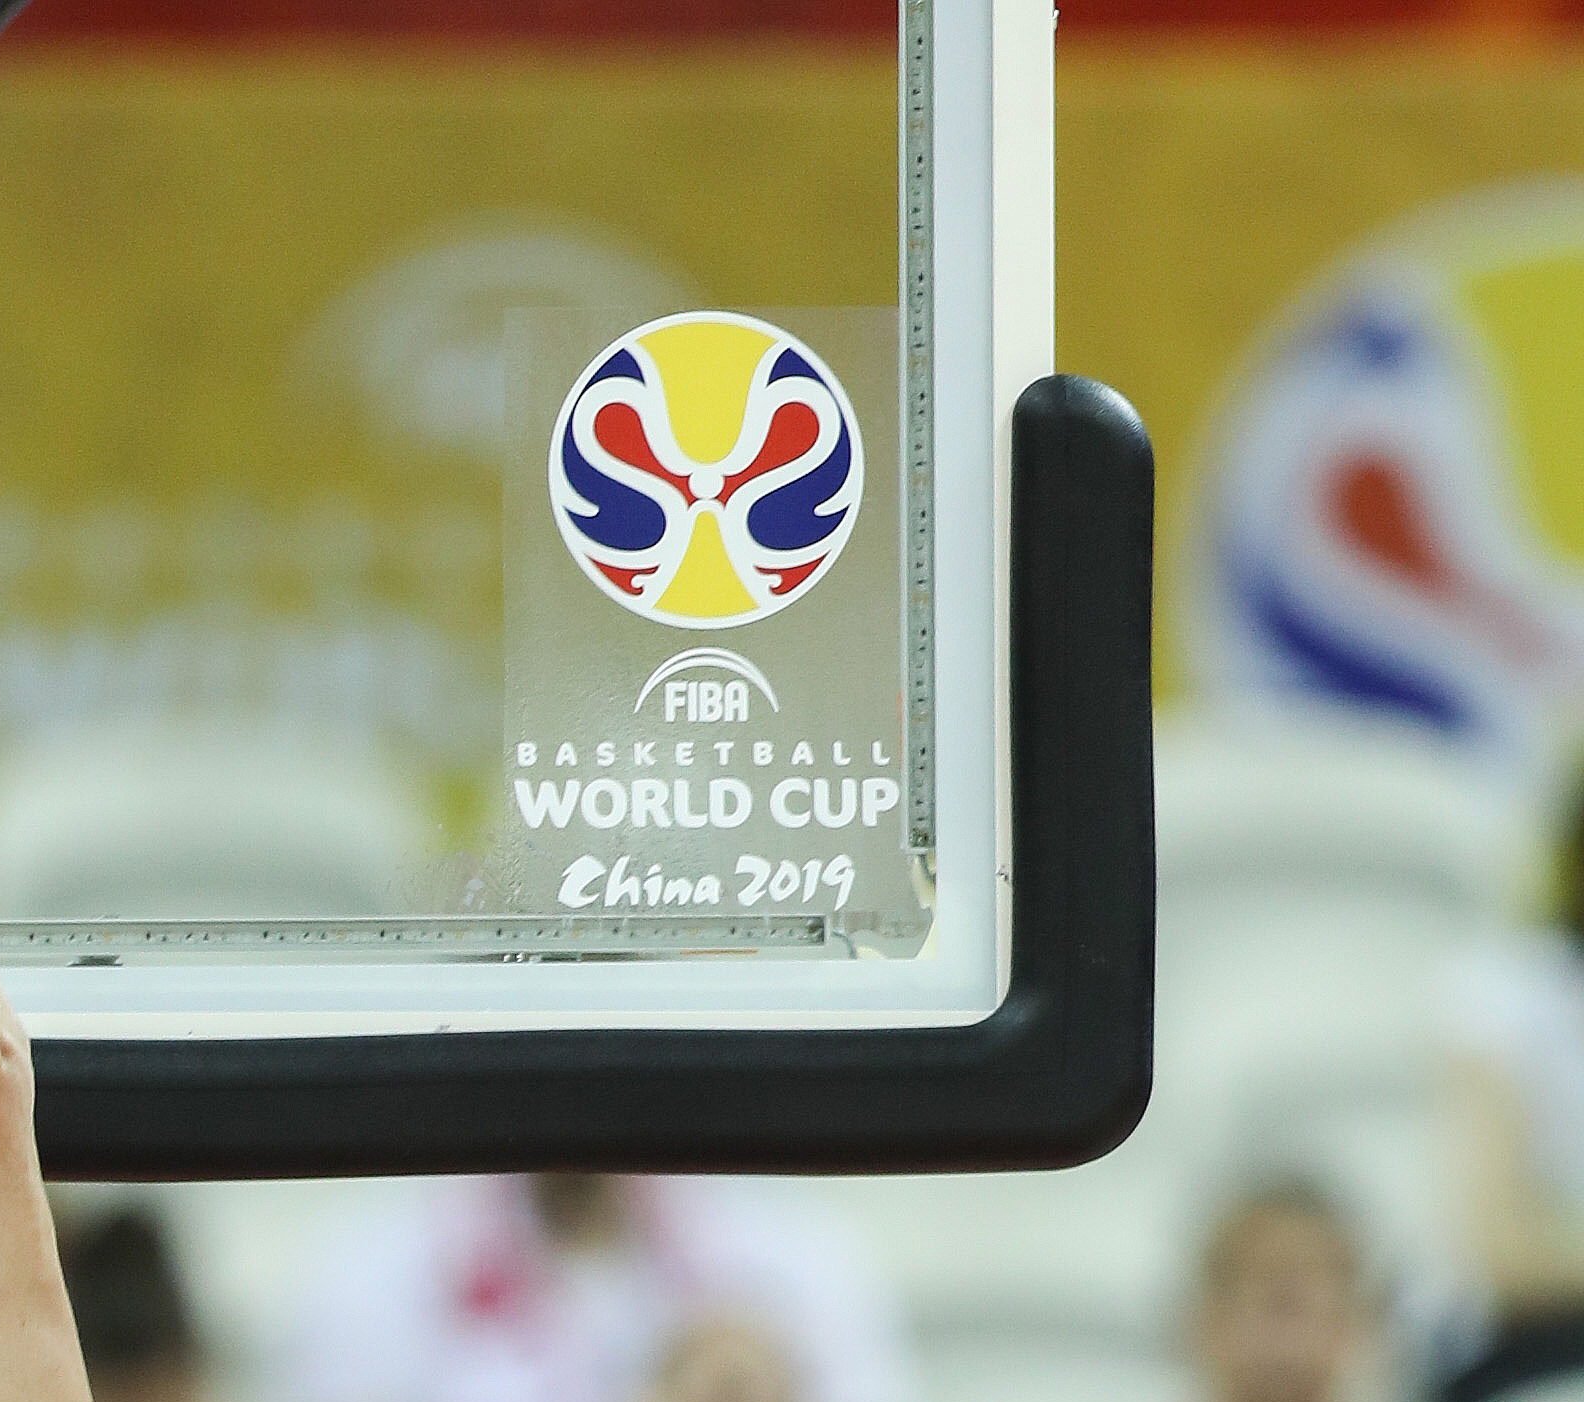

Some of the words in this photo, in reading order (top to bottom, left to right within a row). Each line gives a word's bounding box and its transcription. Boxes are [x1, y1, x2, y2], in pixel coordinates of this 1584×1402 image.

[664, 680, 751, 722] FIBA
[516, 741, 890, 767] BASKETBALL
[514, 778, 754, 828] WORLD
[769, 778, 899, 828] CUP
[557, 854, 722, 908] China
[734, 854, 856, 911] 2019
